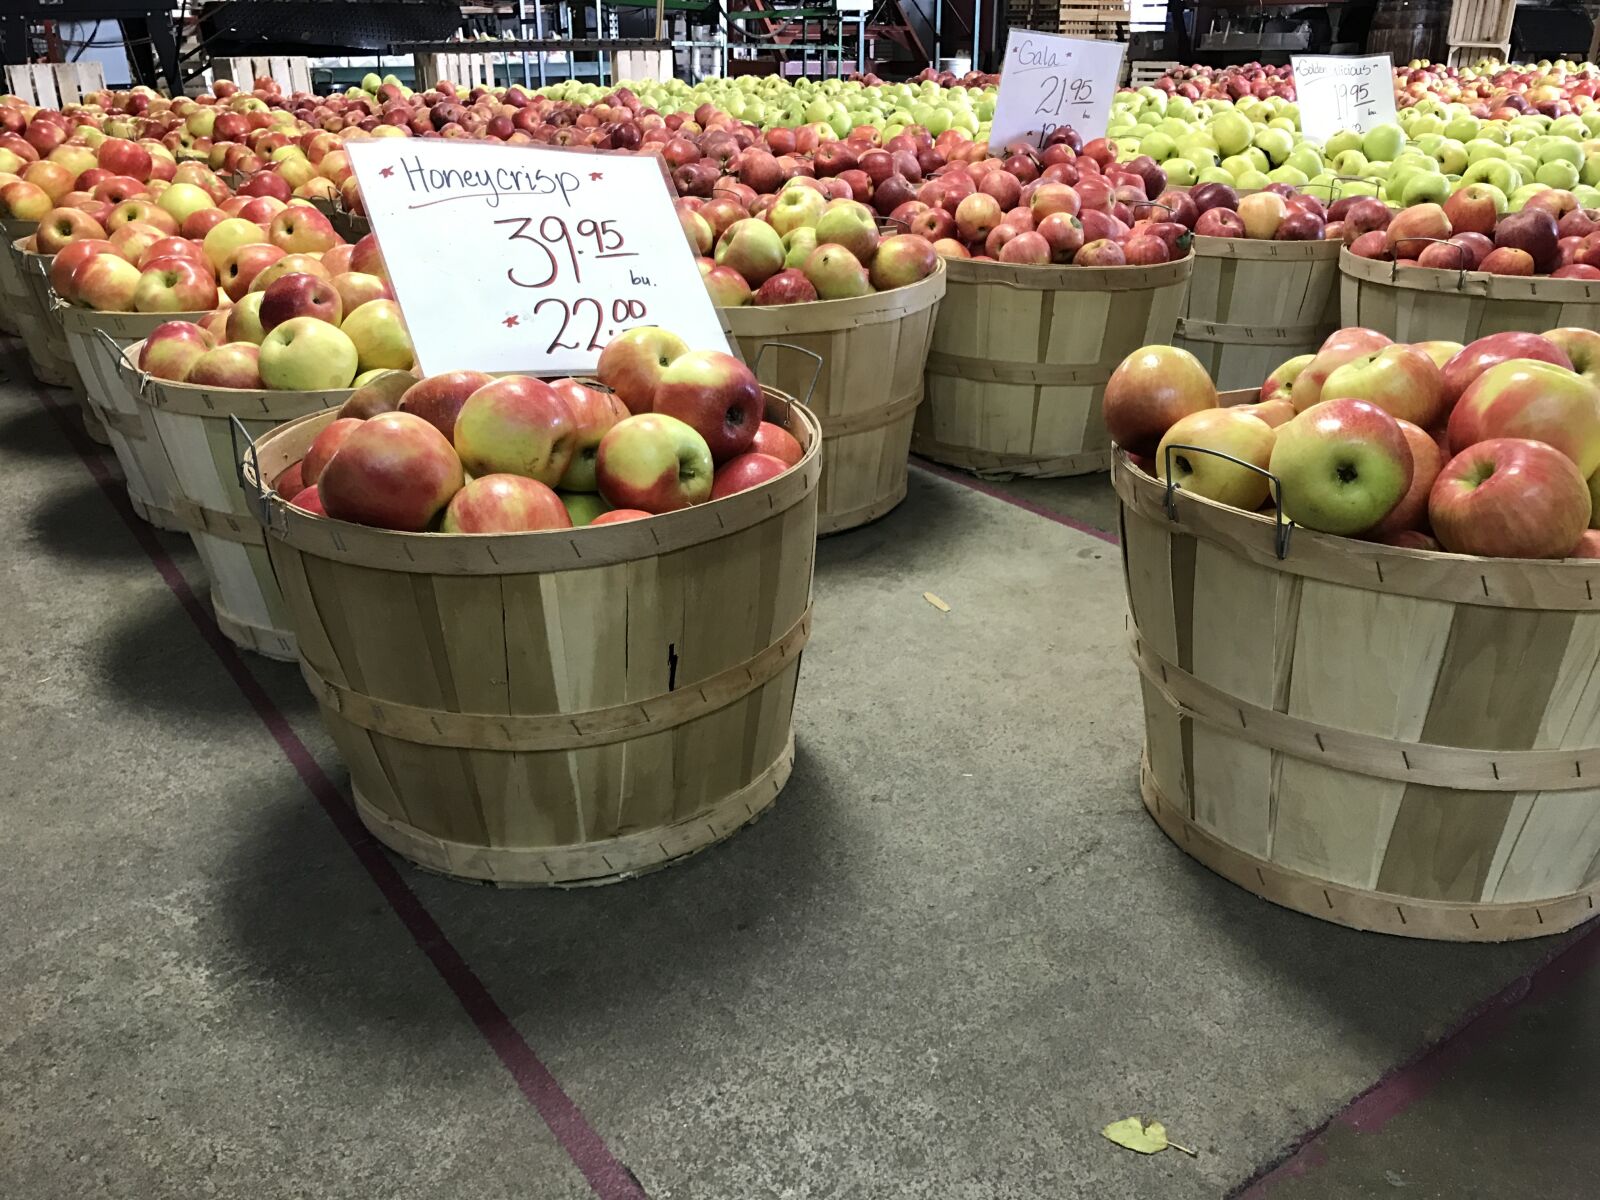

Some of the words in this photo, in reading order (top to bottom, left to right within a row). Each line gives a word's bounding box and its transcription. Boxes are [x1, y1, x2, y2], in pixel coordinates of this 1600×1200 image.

[1018, 40, 1058, 66] Gala
[1035, 75, 1093, 116] 21.95
[400, 155, 580, 207] Honeycrisp
[494, 216, 627, 288] 39.95
[629, 270, 657, 287] bu.
[534, 298, 647, 354] 22.00
